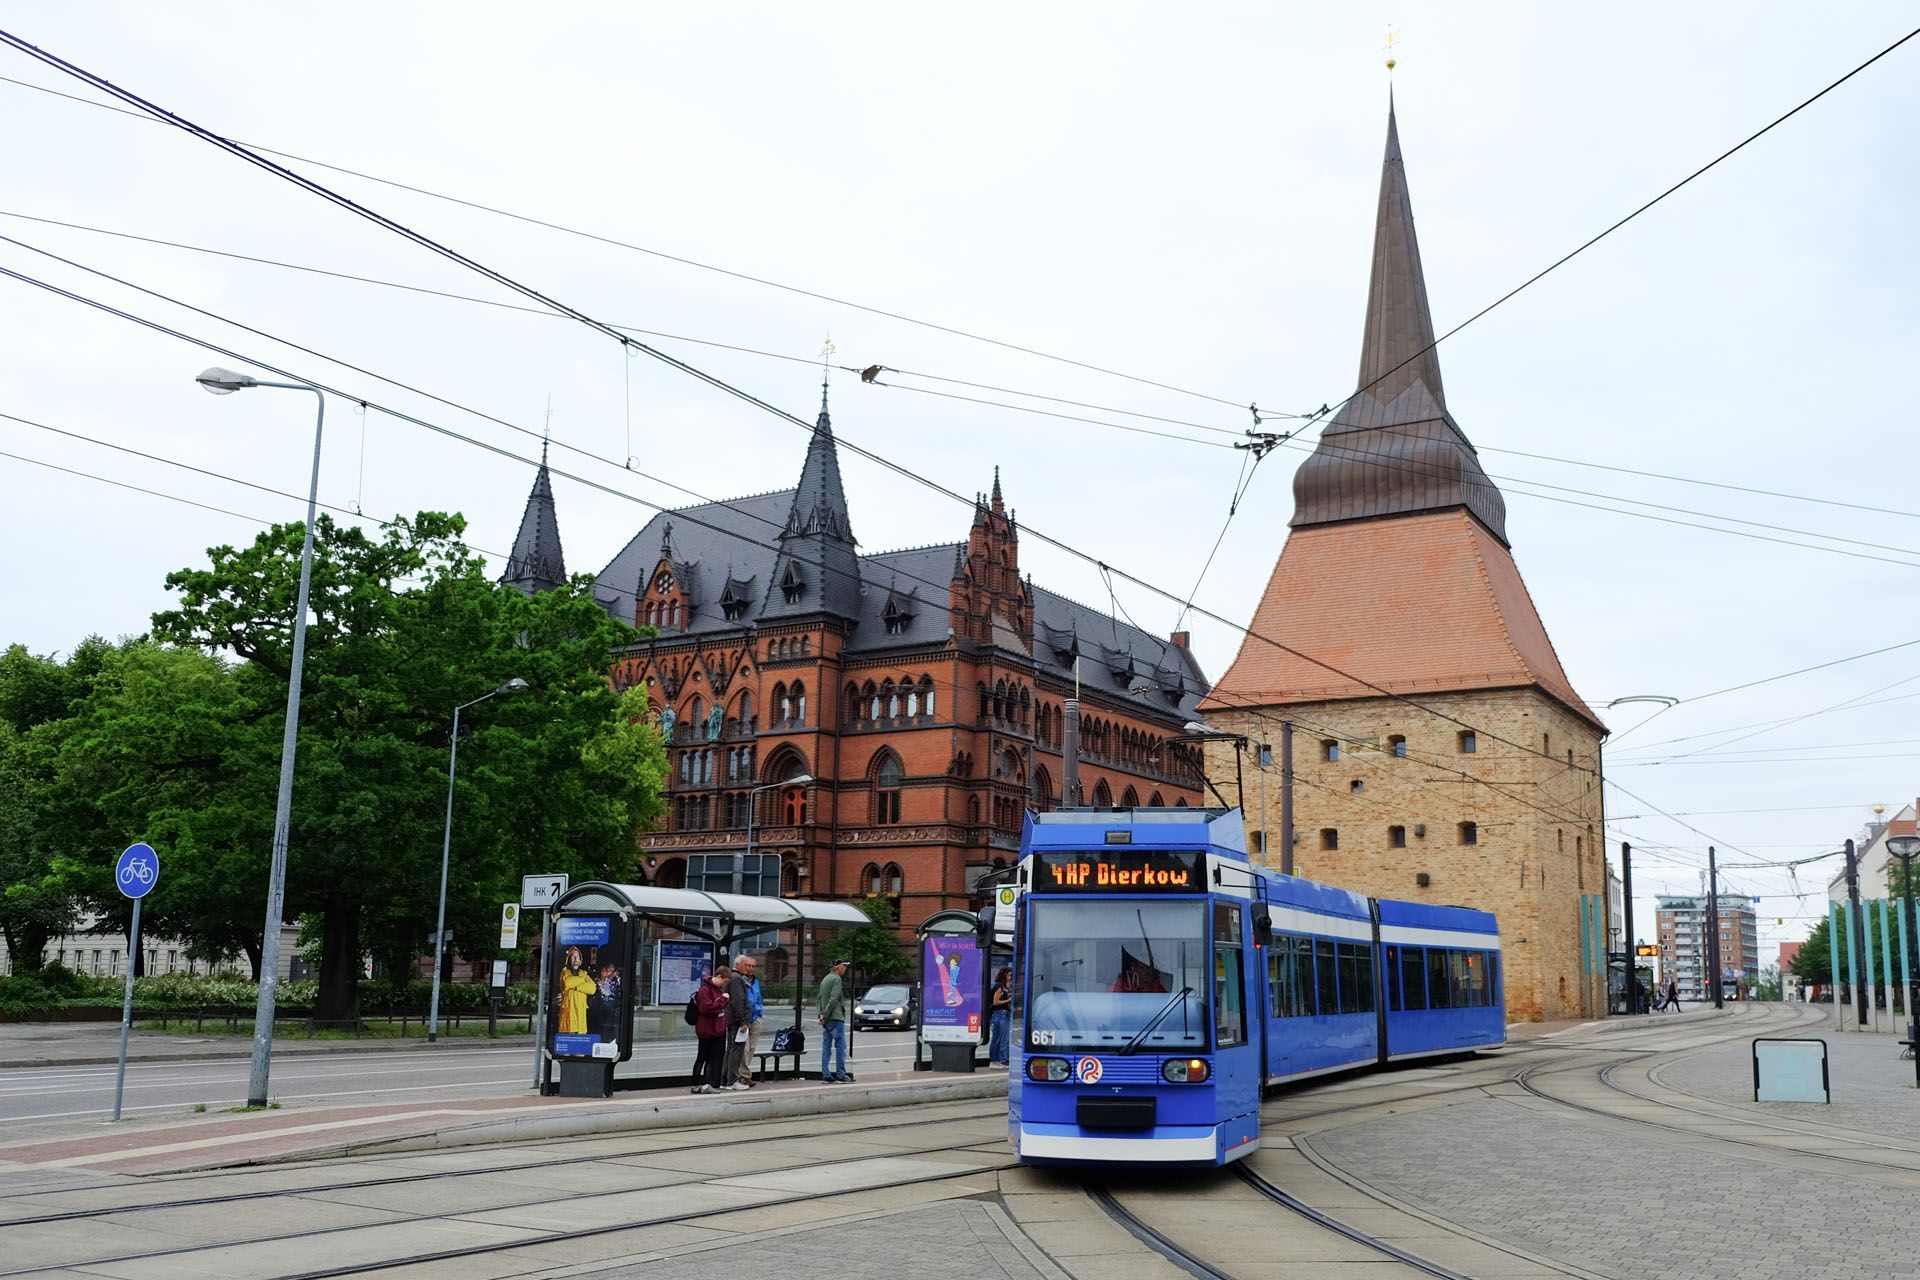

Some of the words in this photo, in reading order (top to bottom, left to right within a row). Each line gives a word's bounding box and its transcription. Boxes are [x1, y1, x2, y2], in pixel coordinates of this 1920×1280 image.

[1097, 863, 1188, 885] Dierkow
[533, 886, 547, 897] IHK
[1031, 1030, 1056, 1045] 661
